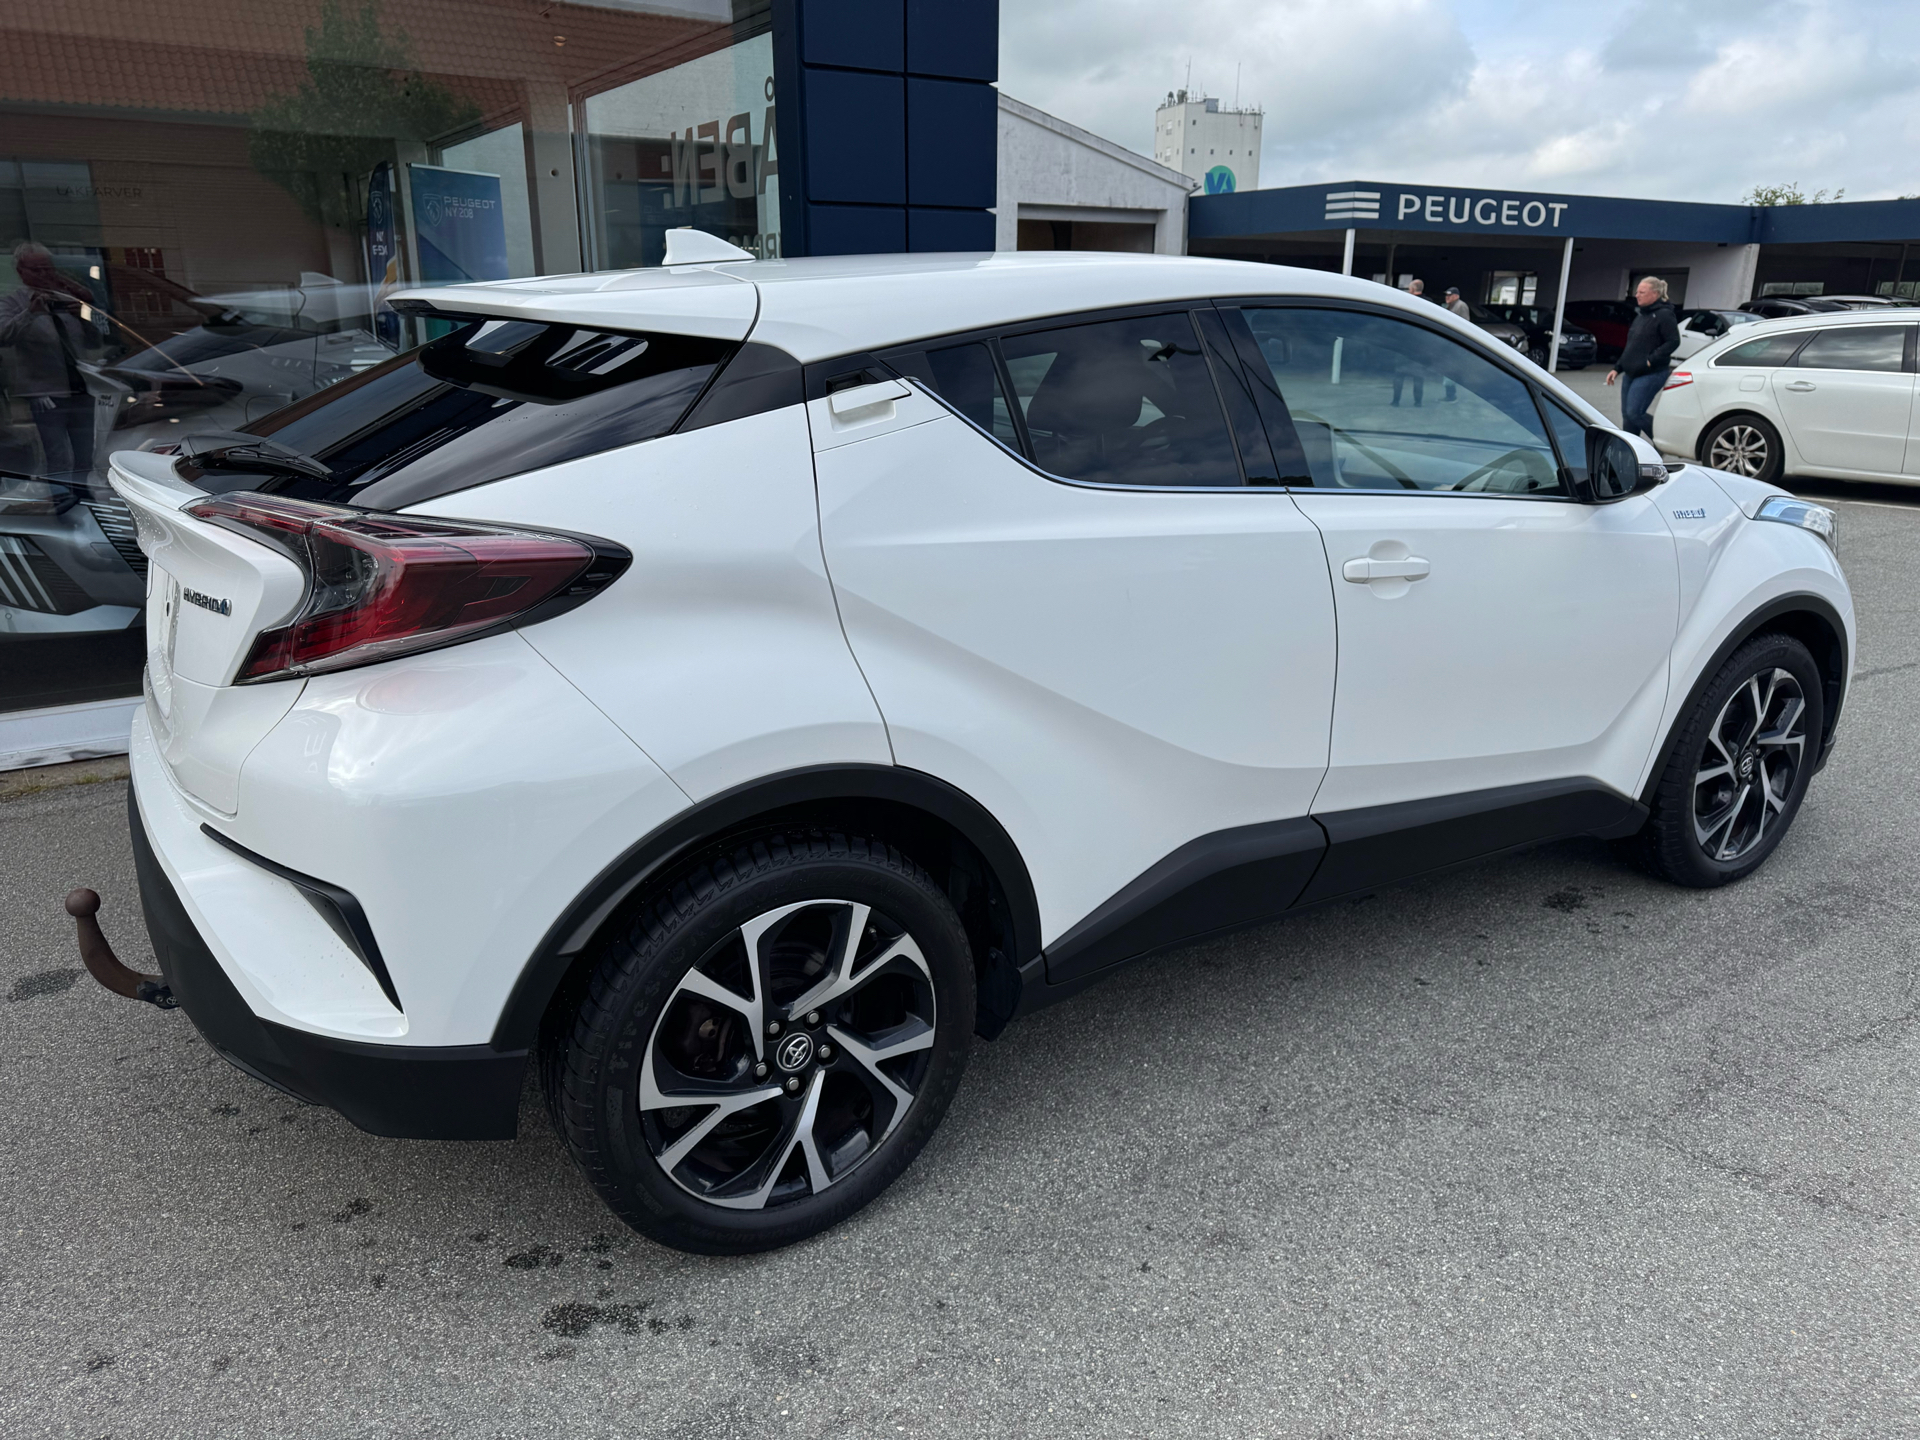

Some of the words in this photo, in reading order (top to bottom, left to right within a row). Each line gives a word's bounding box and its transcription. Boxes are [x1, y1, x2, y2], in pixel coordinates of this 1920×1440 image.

[56, 185, 142, 198] LAKFARVER
[443, 195, 496, 209] PEUGEOT
[445, 207, 457, 218] NY
[459, 207, 474, 219] 208
[1398, 193, 1568, 228] PEUGEOT
[183, 586, 222, 614] HYBRID
